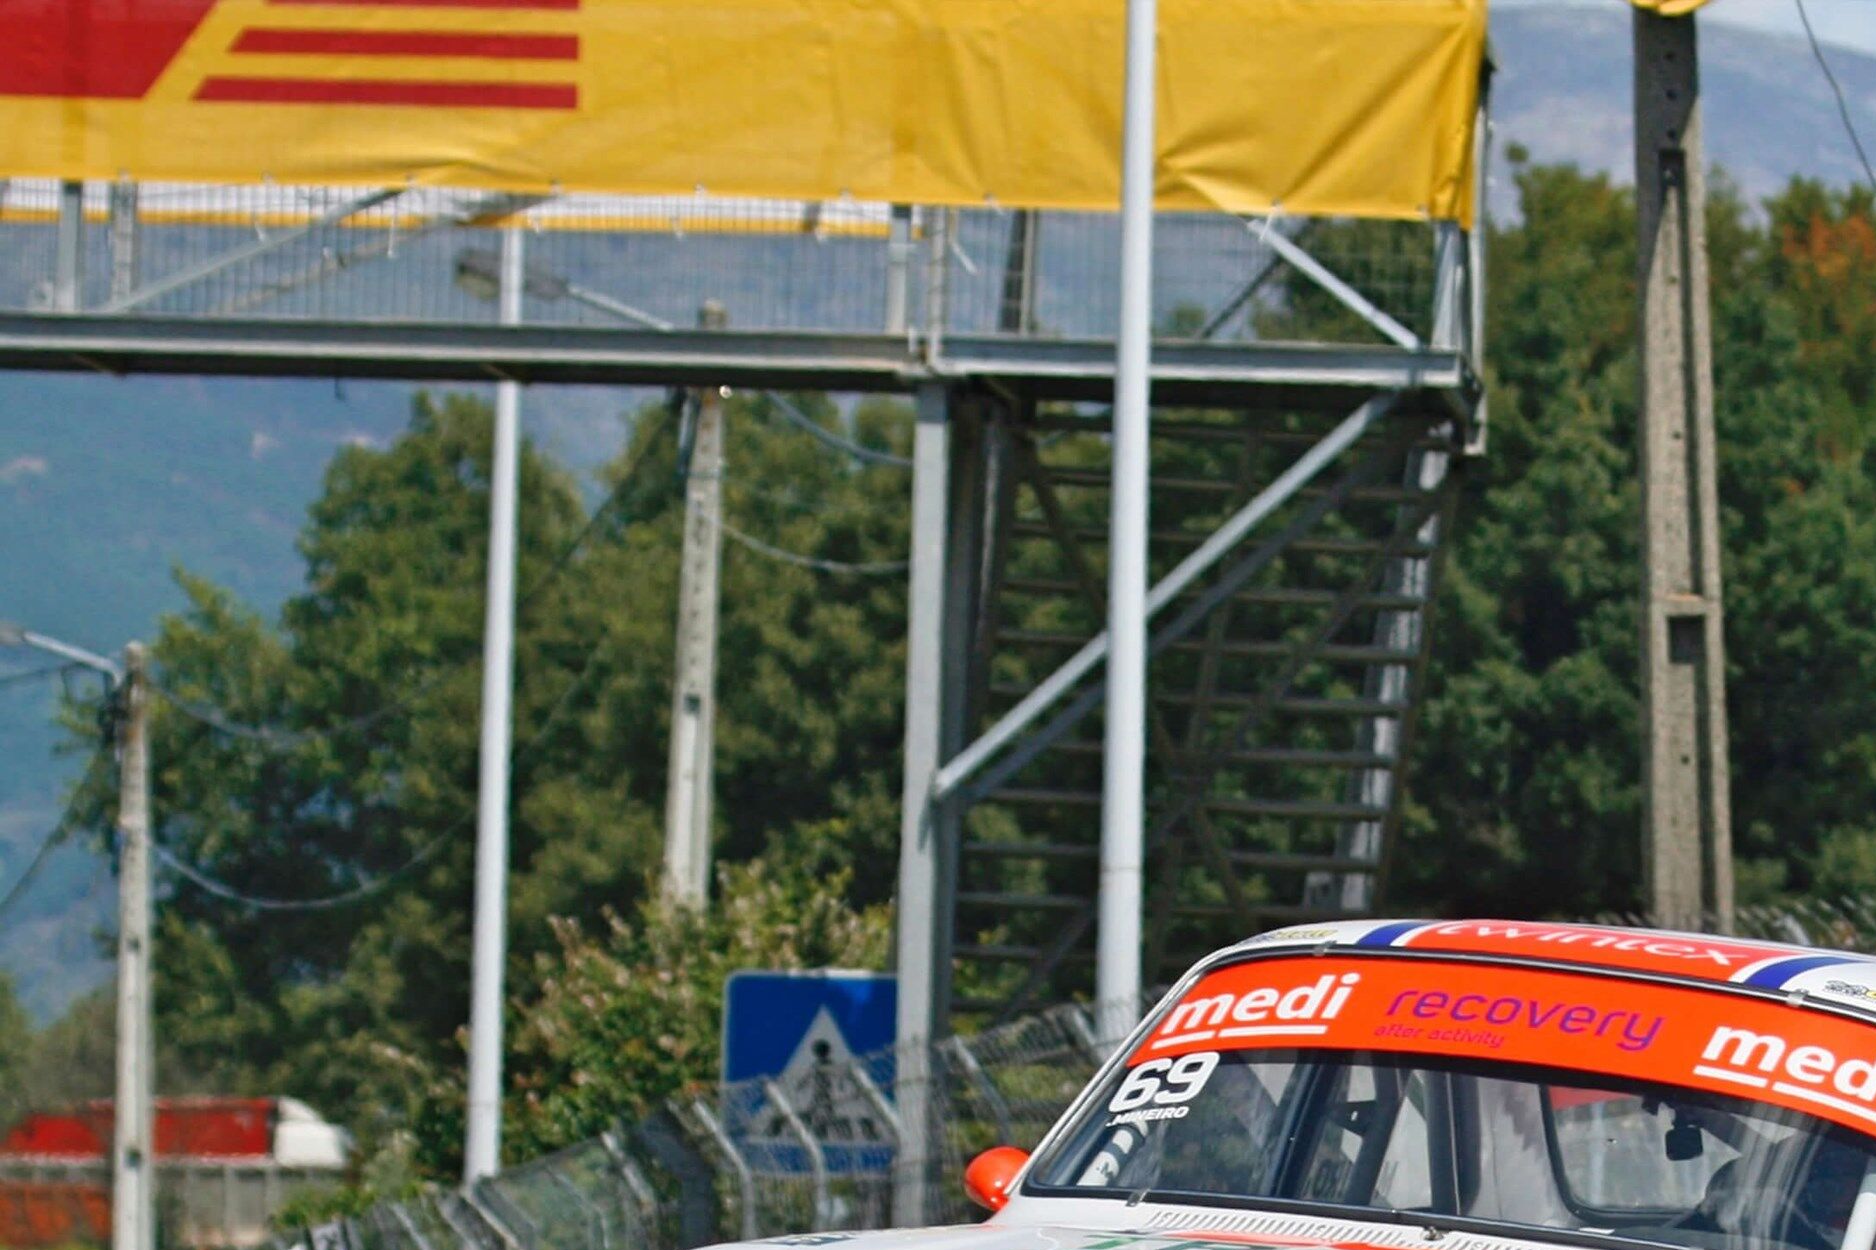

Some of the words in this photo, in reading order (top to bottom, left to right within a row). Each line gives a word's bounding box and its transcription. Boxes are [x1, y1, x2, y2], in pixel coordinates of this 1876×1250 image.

[1161, 972, 1362, 1034] medi
[1387, 990, 1665, 1051] recovery
[1374, 1024, 1421, 1039] after
[1427, 1026, 1505, 1048] activity
[1108, 1051, 1219, 1112] 69
